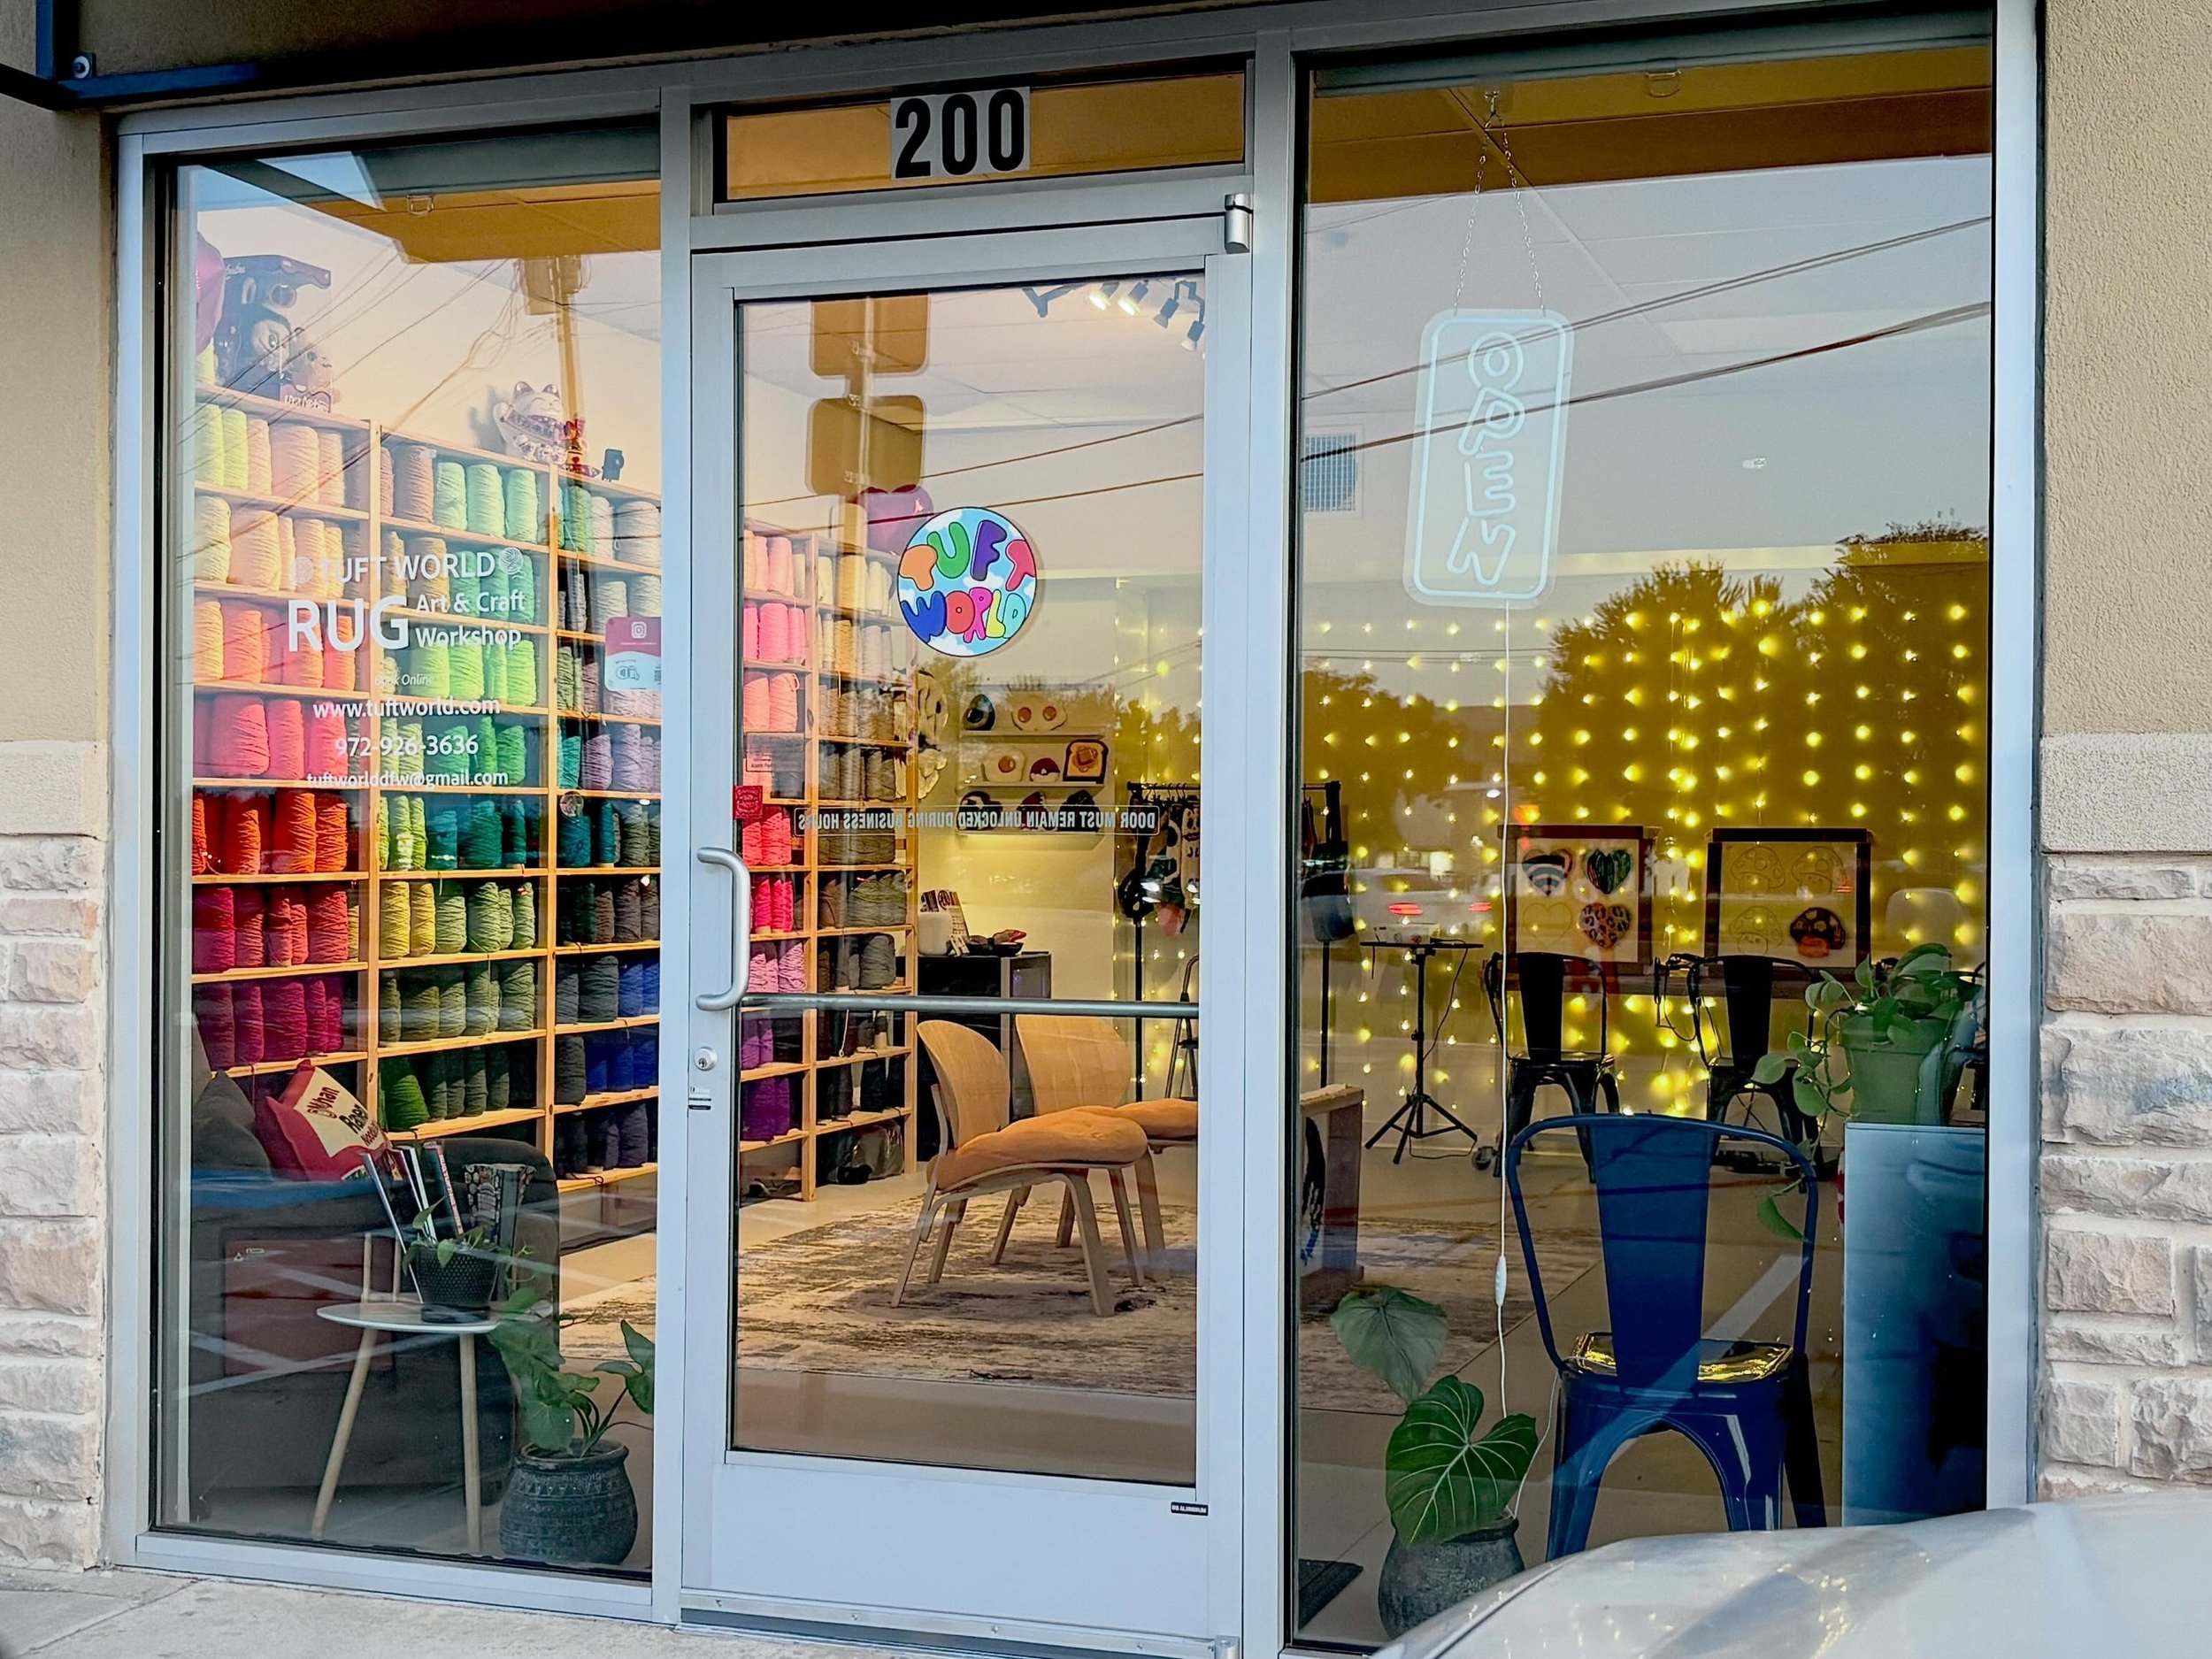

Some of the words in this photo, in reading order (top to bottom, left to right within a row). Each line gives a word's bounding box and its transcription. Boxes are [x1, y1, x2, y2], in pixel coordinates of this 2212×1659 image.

[895, 89, 1025, 179] 200
[1446, 331, 1525, 586] OPEN
[319, 557, 387, 584] TUFT
[394, 551, 495, 580] WORLD
[899, 519, 1037, 592] TUFT
[416, 594, 449, 613] Art
[453, 593, 471, 613] &
[476, 588, 526, 612] Craft
[900, 587, 1026, 643] WORLD
[288, 595, 410, 653] RUG
[415, 625, 521, 651] Workshop
[312, 696, 500, 718] www.tuftworld.com
[334, 733, 480, 757] 972-926-3636
[306, 768, 509, 788] tuftworlddfw@gmail.com
